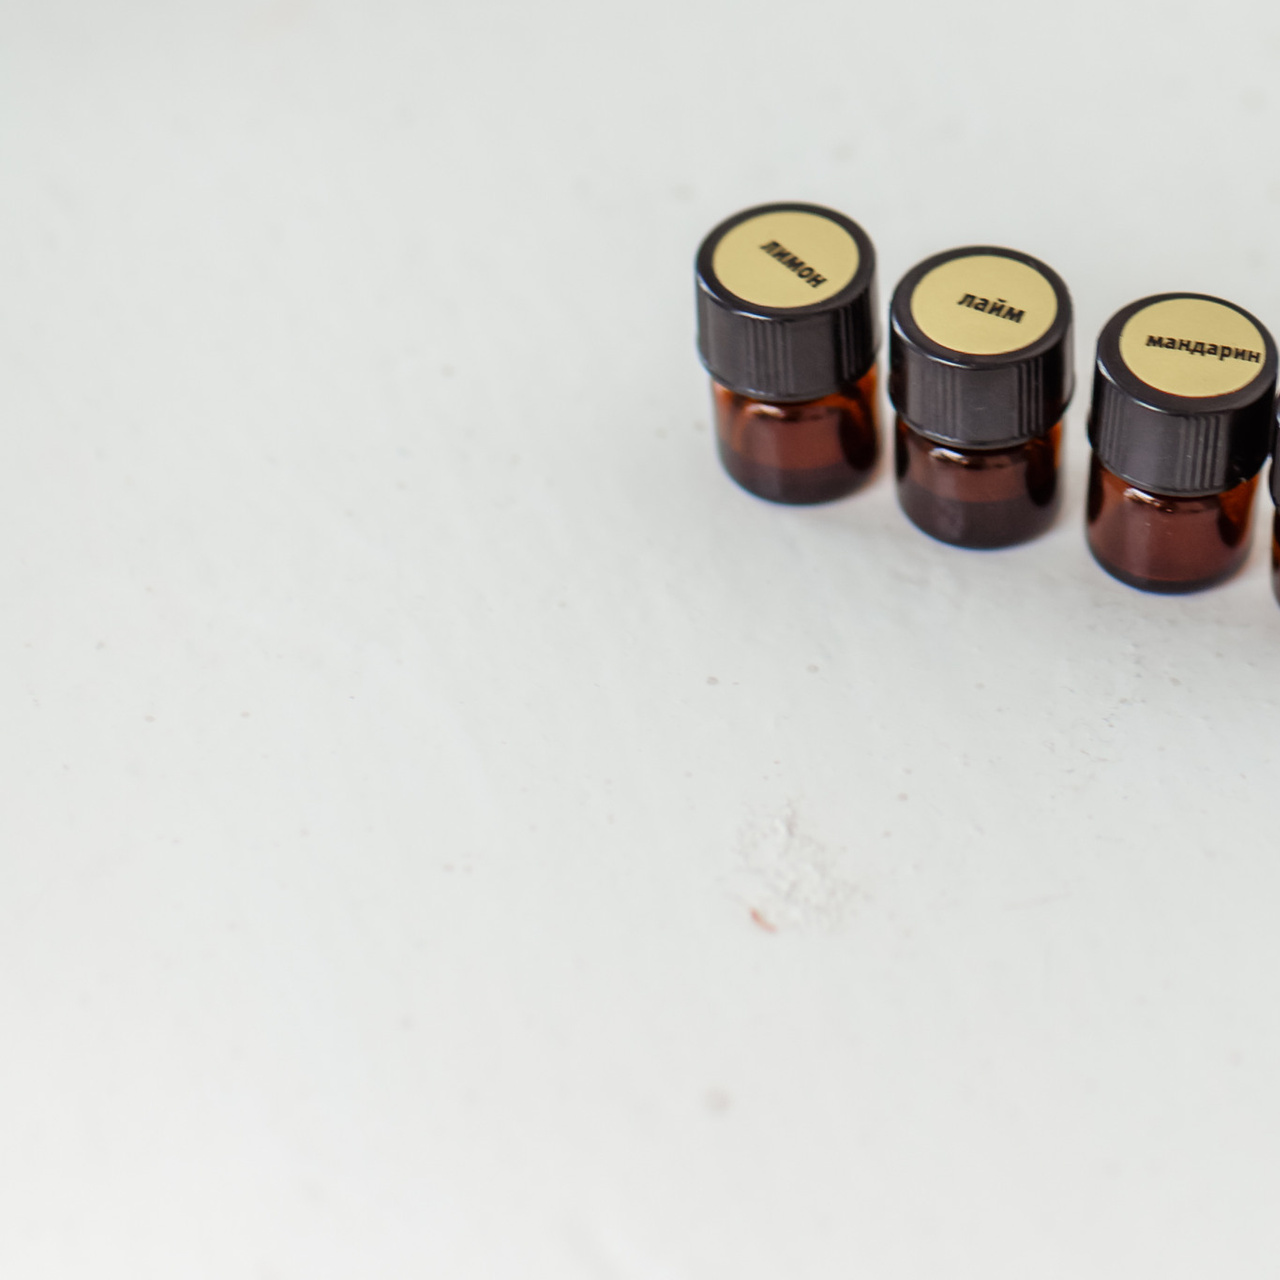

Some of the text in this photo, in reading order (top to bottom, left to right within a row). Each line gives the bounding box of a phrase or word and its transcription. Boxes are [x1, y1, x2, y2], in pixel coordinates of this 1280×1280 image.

[760, 240, 828, 289] лимон
[957, 293, 1026, 324] лайм
[1145, 335, 1262, 364] мандарин
